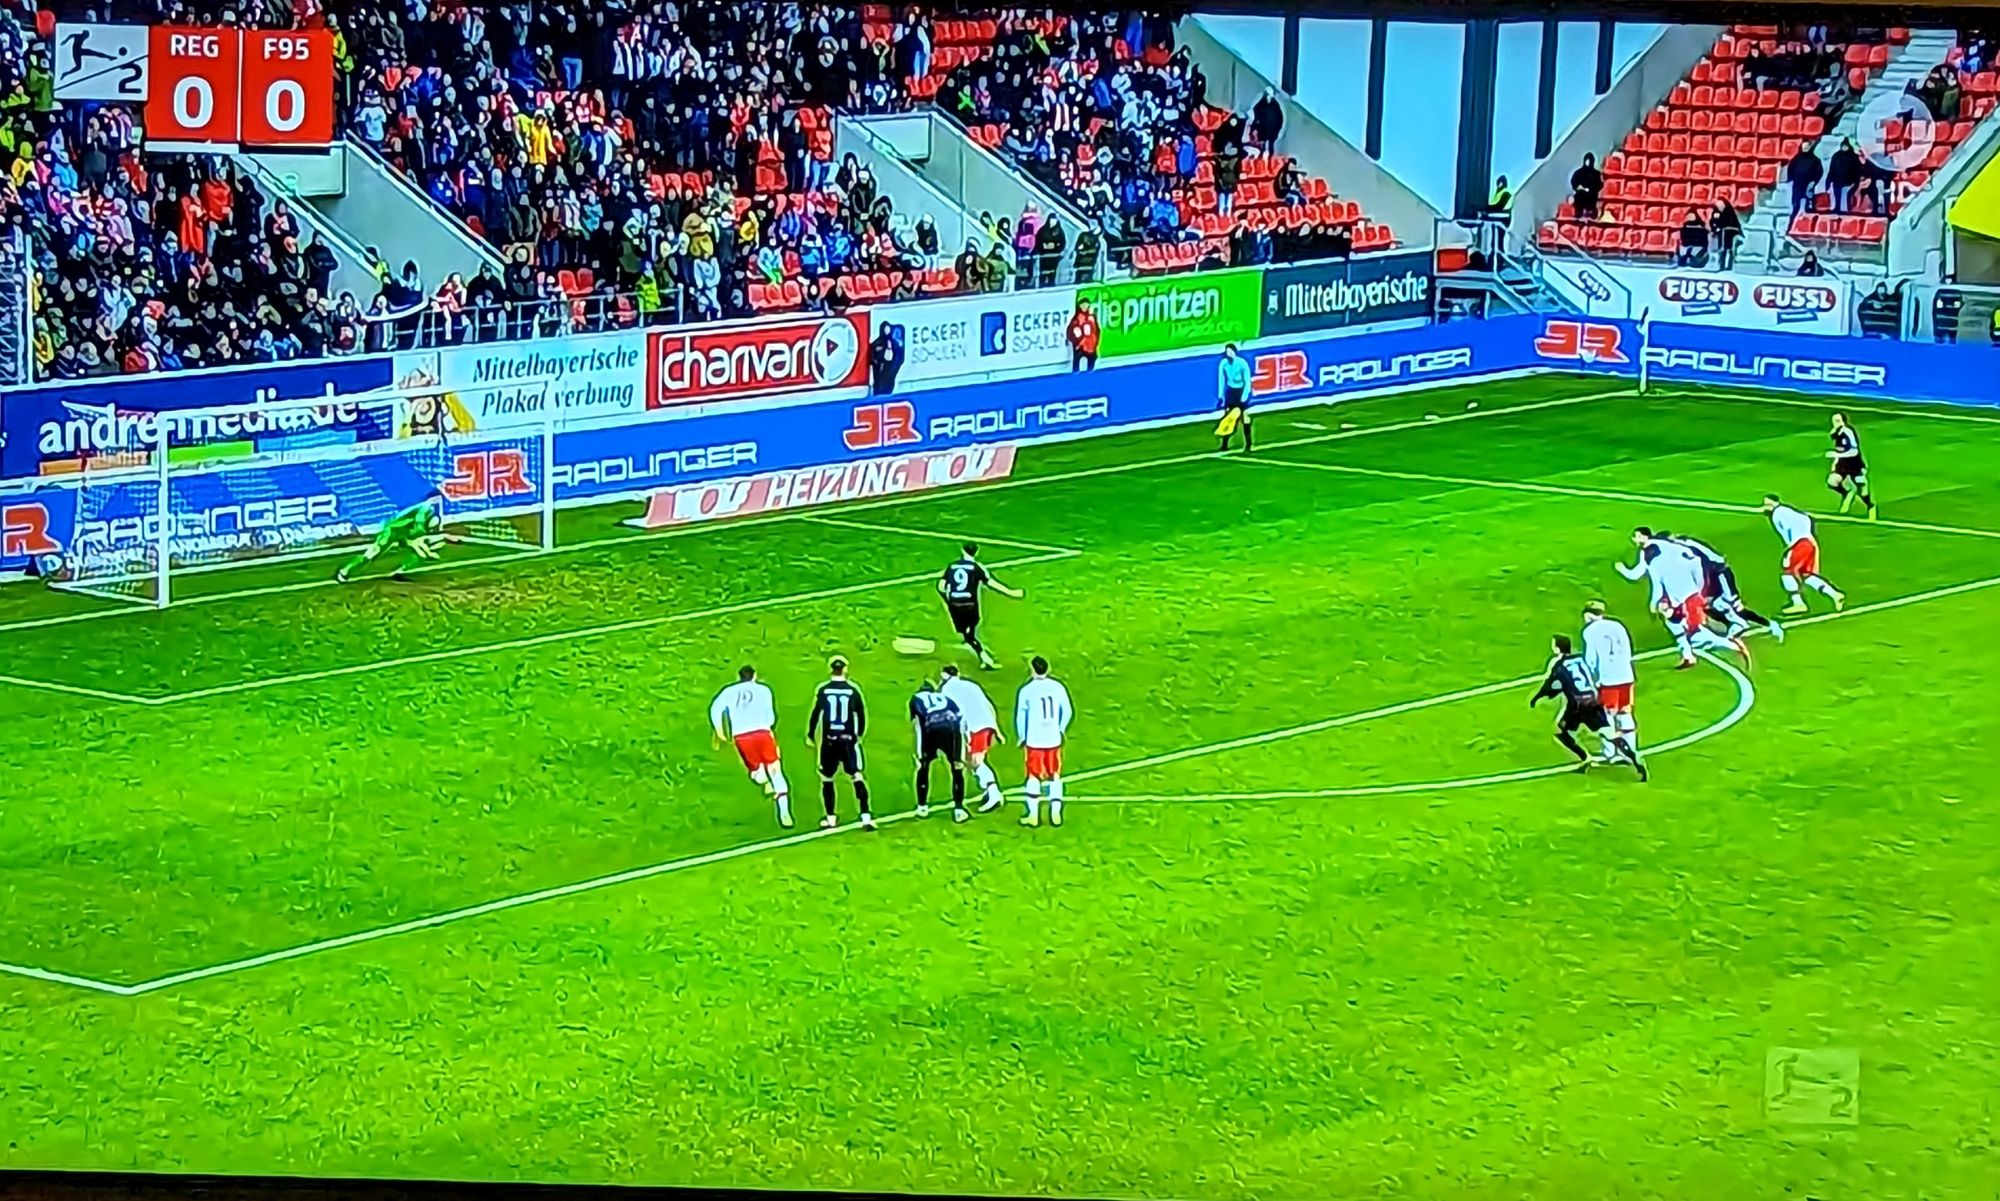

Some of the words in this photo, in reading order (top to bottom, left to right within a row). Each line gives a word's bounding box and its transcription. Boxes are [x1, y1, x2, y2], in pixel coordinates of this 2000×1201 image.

[1285, 271, 1428, 317] Mittelbayerische
[1665, 279, 1735, 303] FUSSL
[1761, 286, 1831, 310] FUSSL
[912, 321, 967, 344] ECKERT
[1013, 310, 1070, 333] ECKERT
[473, 345, 639, 383] Mittelbayerische
[765, 458, 911, 509] HEIZUNG
[952, 567, 969, 591] 9
[826, 694, 850, 724] 11
[1040, 695, 1055, 720] 11
